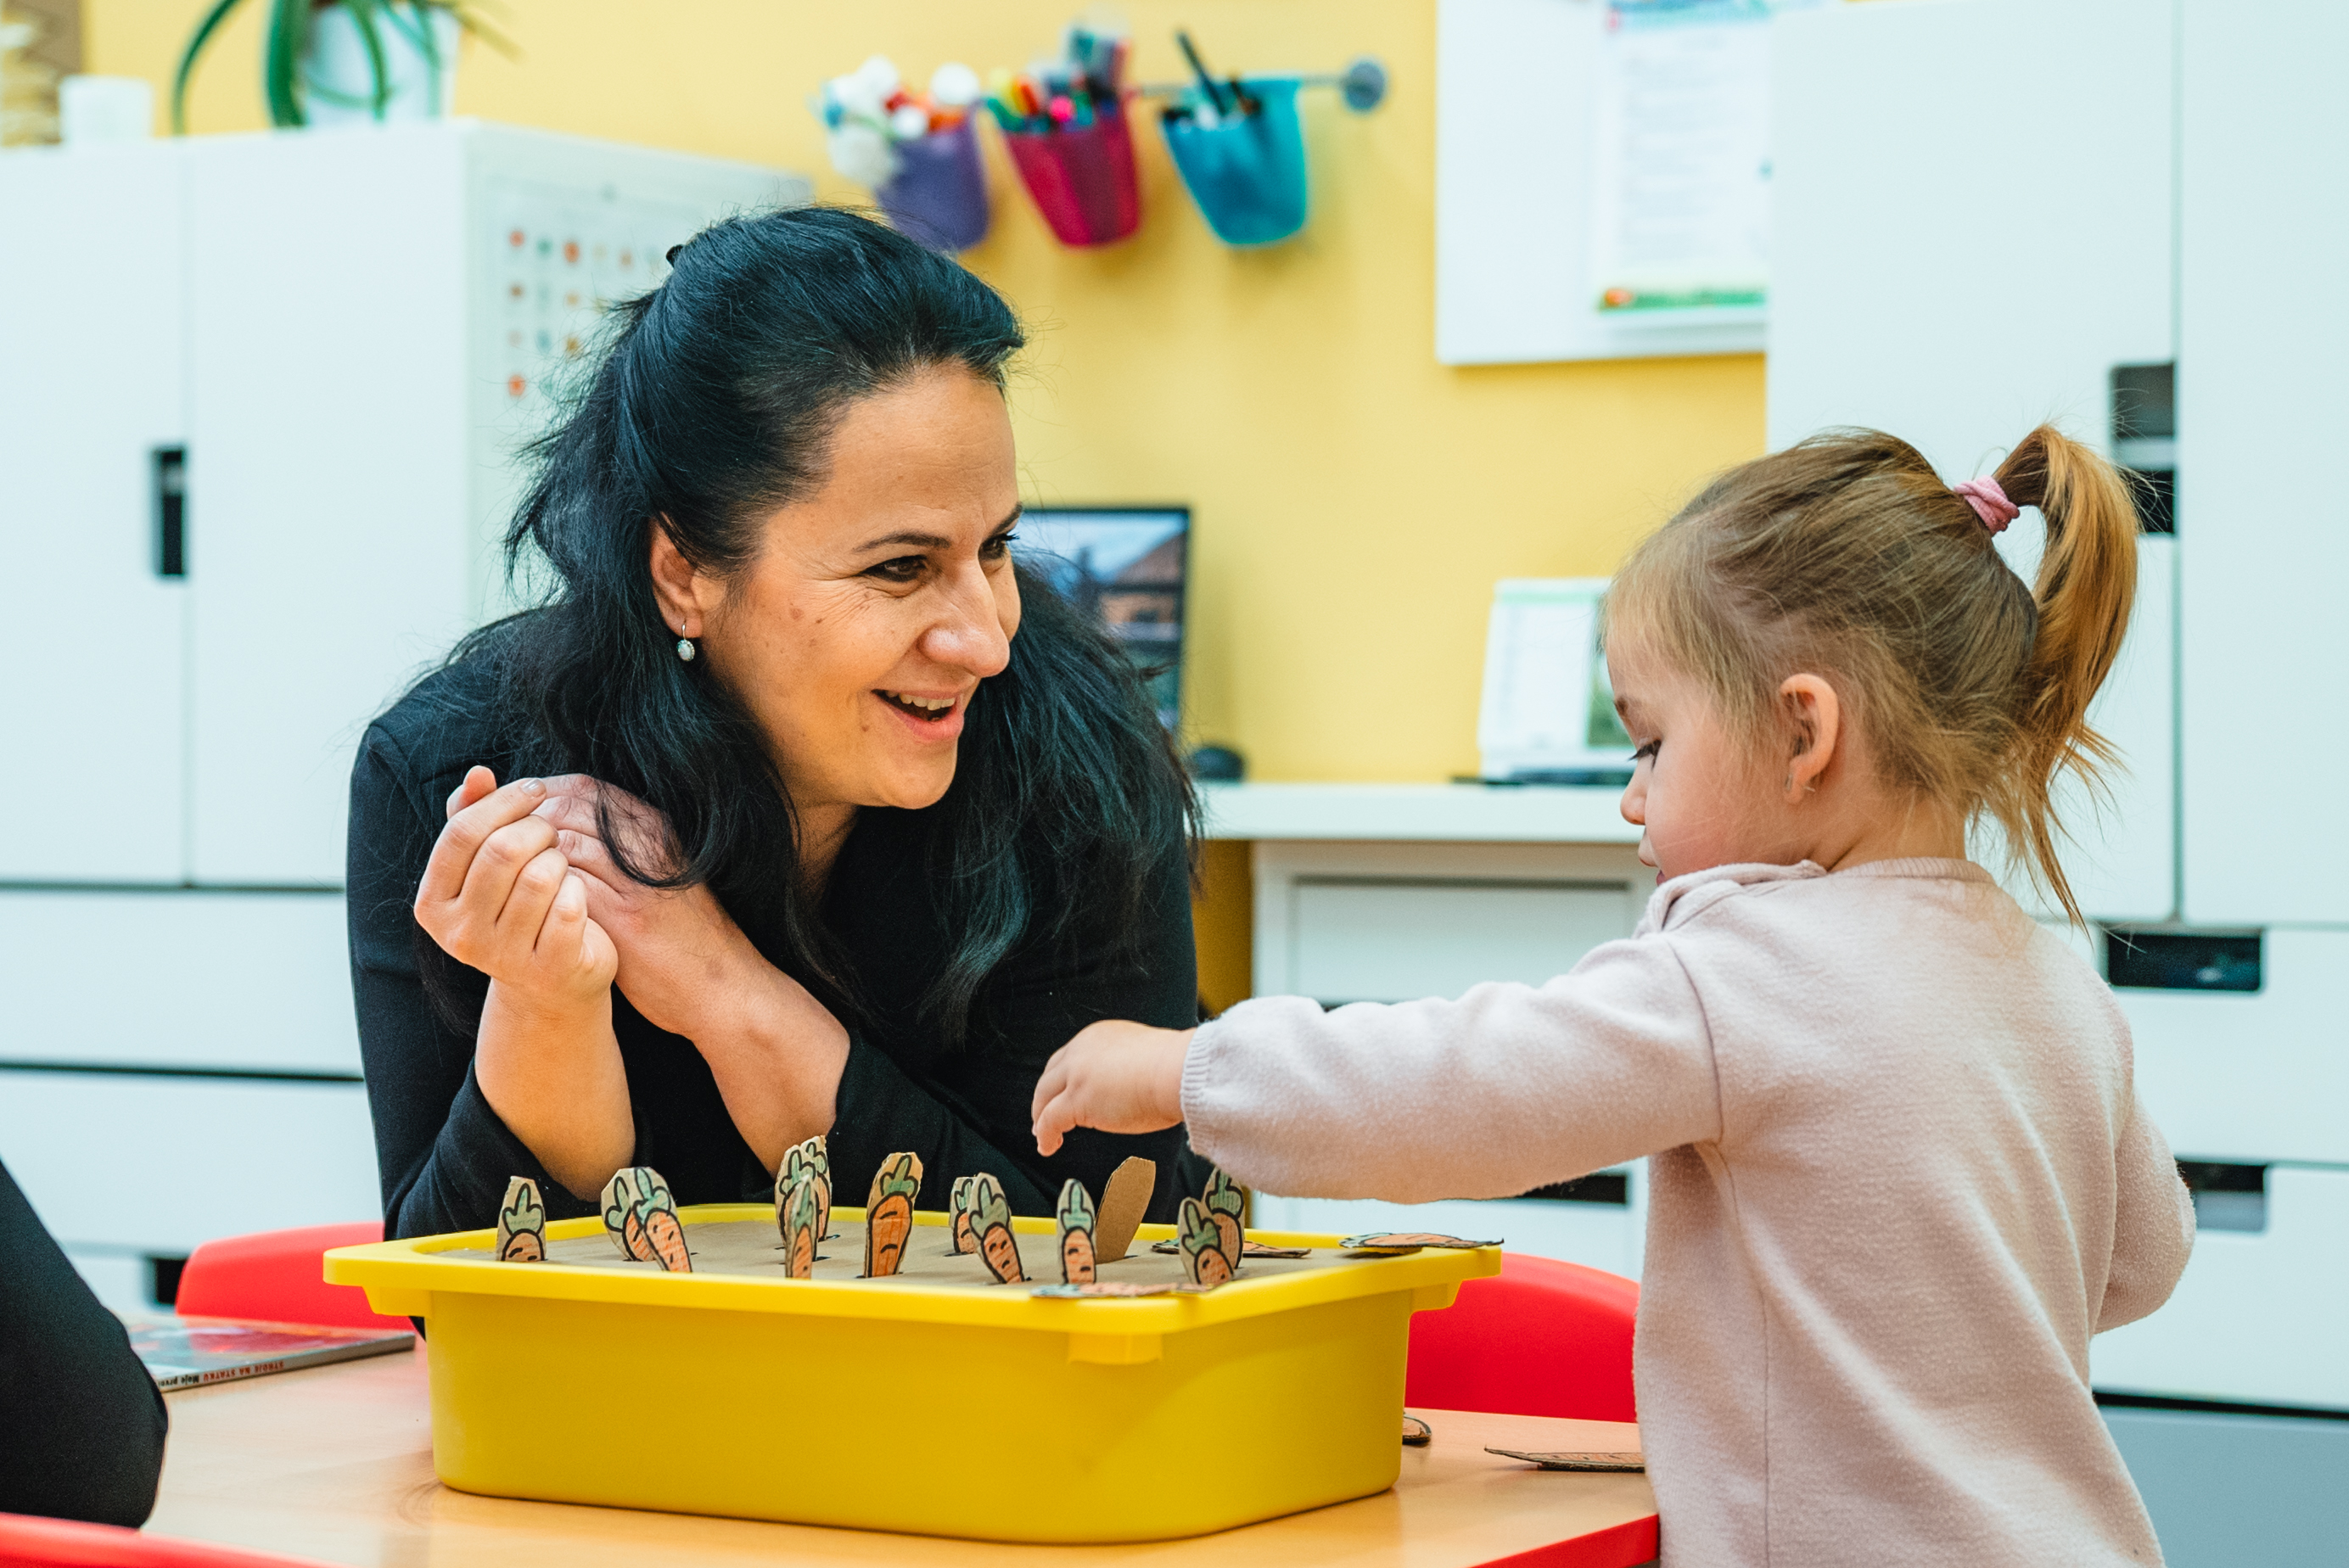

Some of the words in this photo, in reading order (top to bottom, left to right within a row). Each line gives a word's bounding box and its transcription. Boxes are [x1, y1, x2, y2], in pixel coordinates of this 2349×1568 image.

[238, 1366, 251, 1375] NA
[255, 1359, 284, 1372] STROJE
[181, 1373, 200, 1386] Moje
[203, 1369, 236, 1381] STATKU
